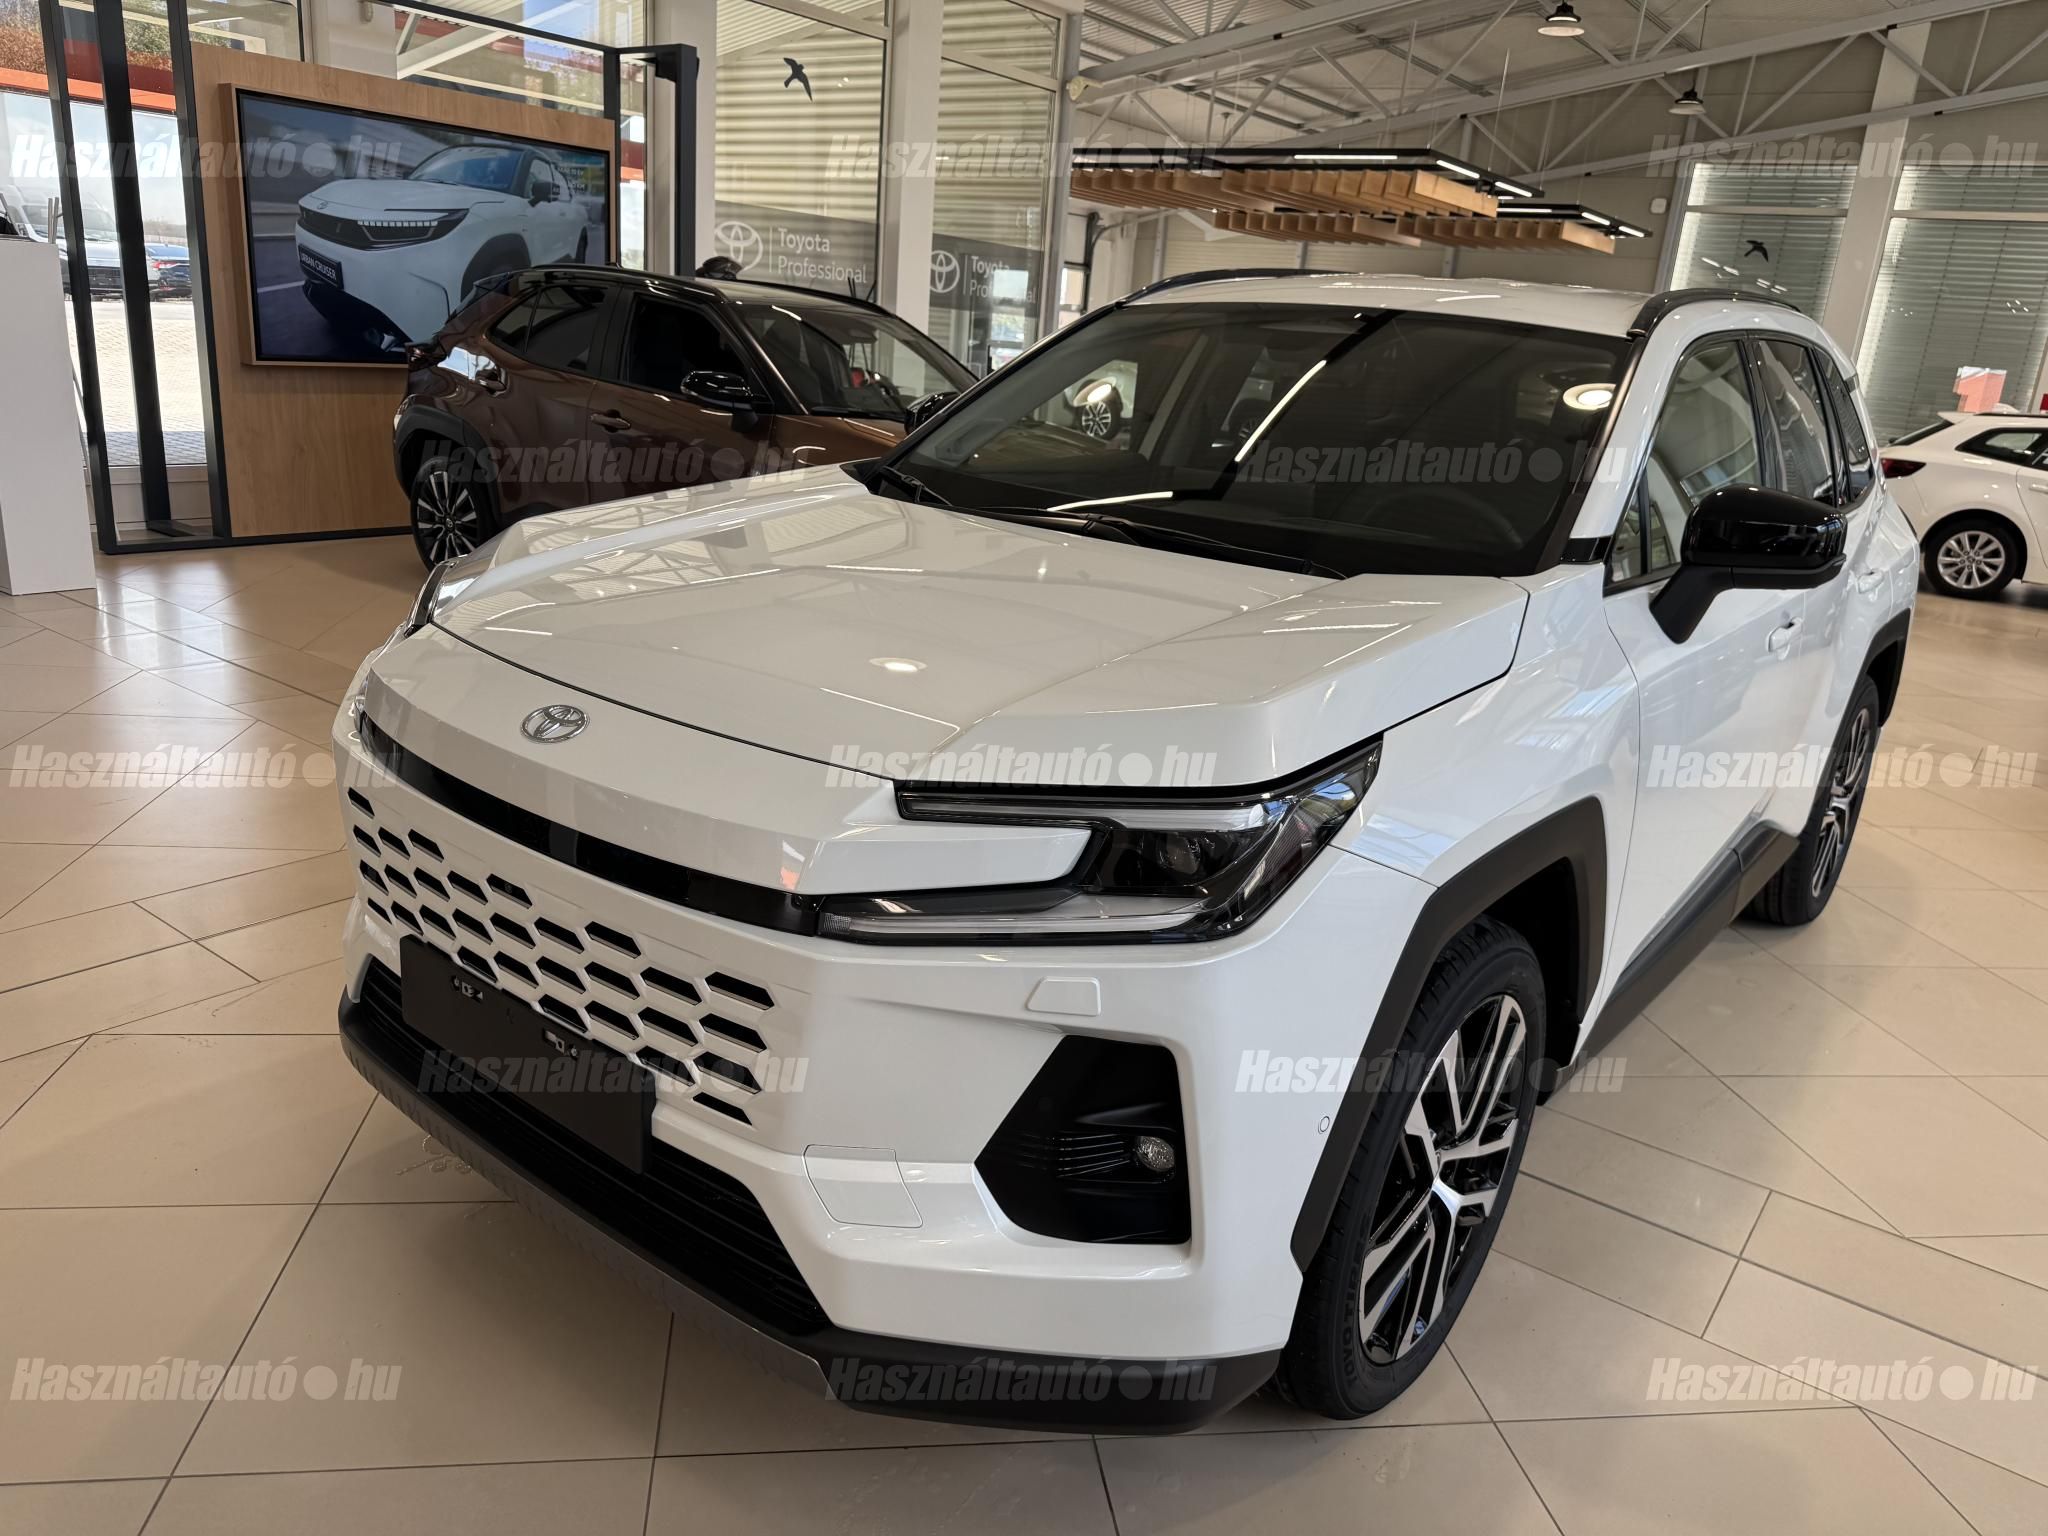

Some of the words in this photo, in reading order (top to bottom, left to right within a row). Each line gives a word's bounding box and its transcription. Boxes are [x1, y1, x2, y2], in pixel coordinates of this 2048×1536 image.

[778, 227, 830, 254] Toyota
[315, 260, 337, 281] CRUISER
[778, 255, 867, 283] Professional
